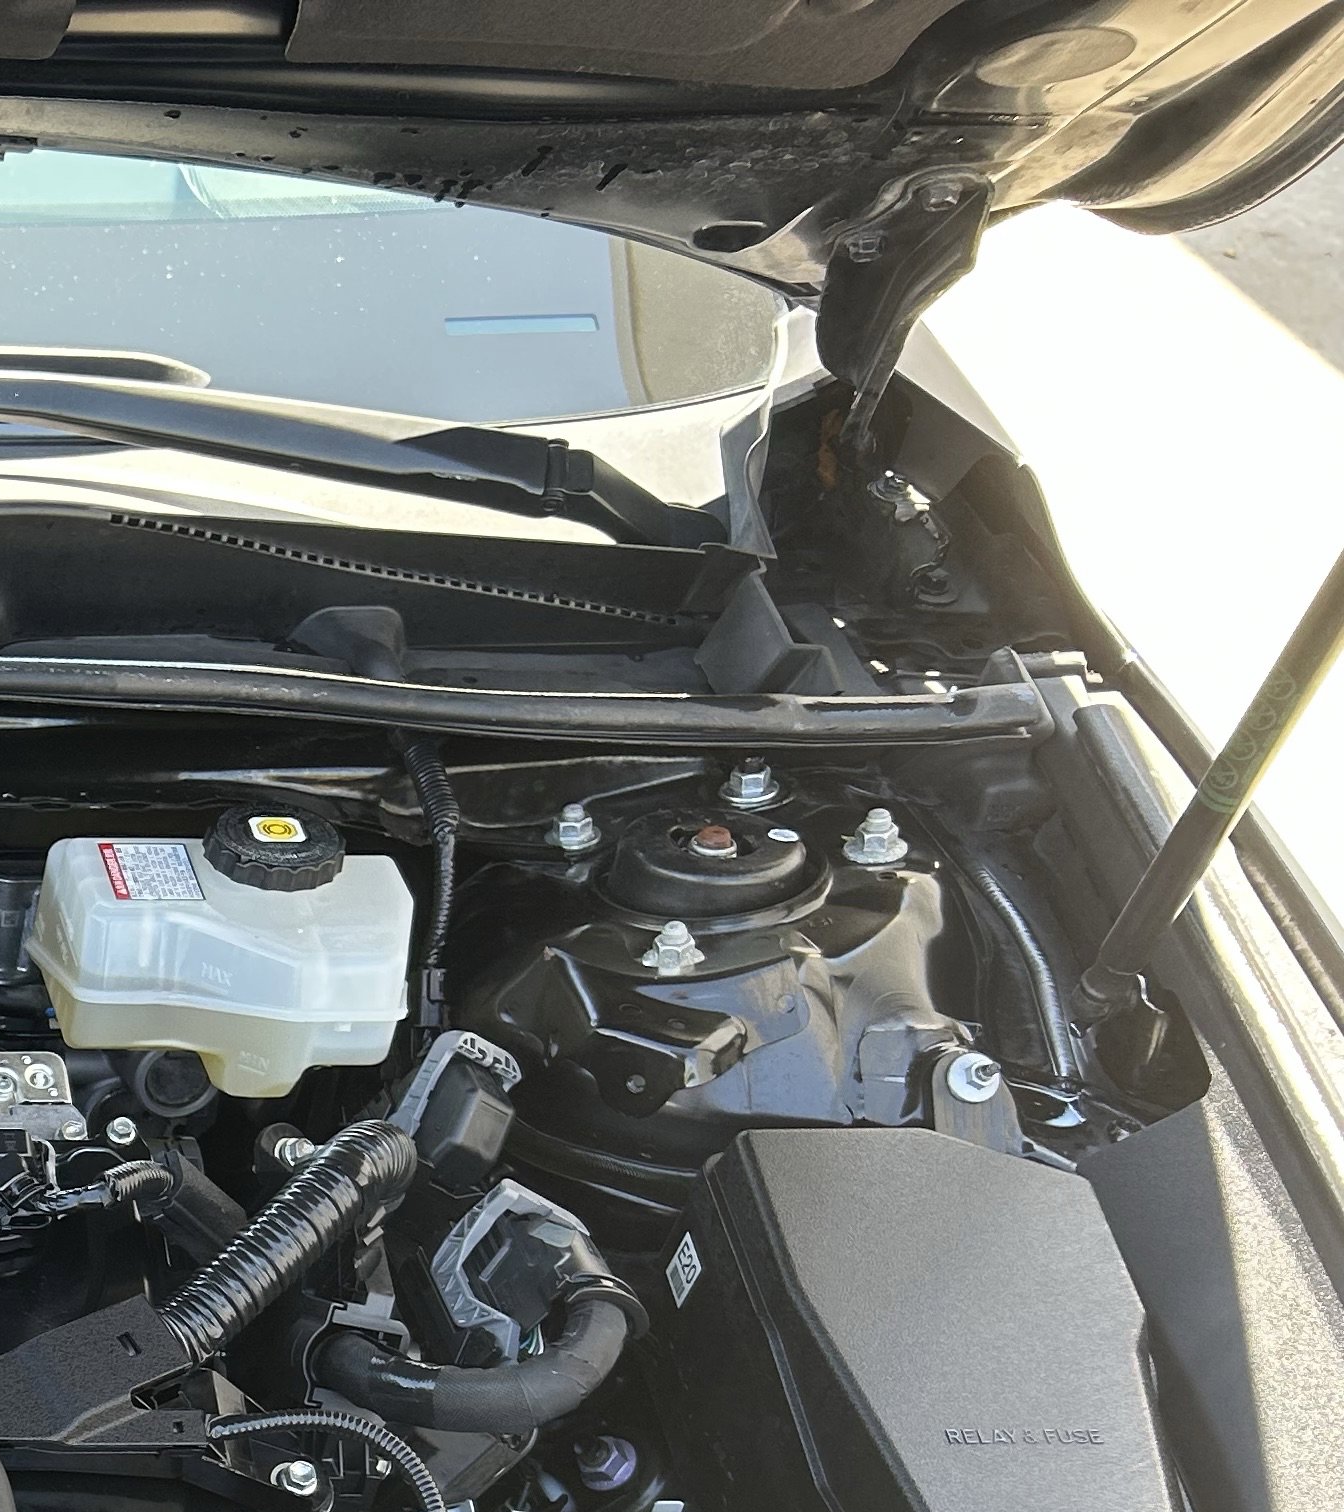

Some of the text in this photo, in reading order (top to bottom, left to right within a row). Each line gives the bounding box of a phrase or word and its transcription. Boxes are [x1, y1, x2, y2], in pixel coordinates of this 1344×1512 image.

[678, 1241, 697, 1284] E20
[945, 1428, 1016, 1445] RELAY
[1043, 1428, 1105, 1445] FUSE
